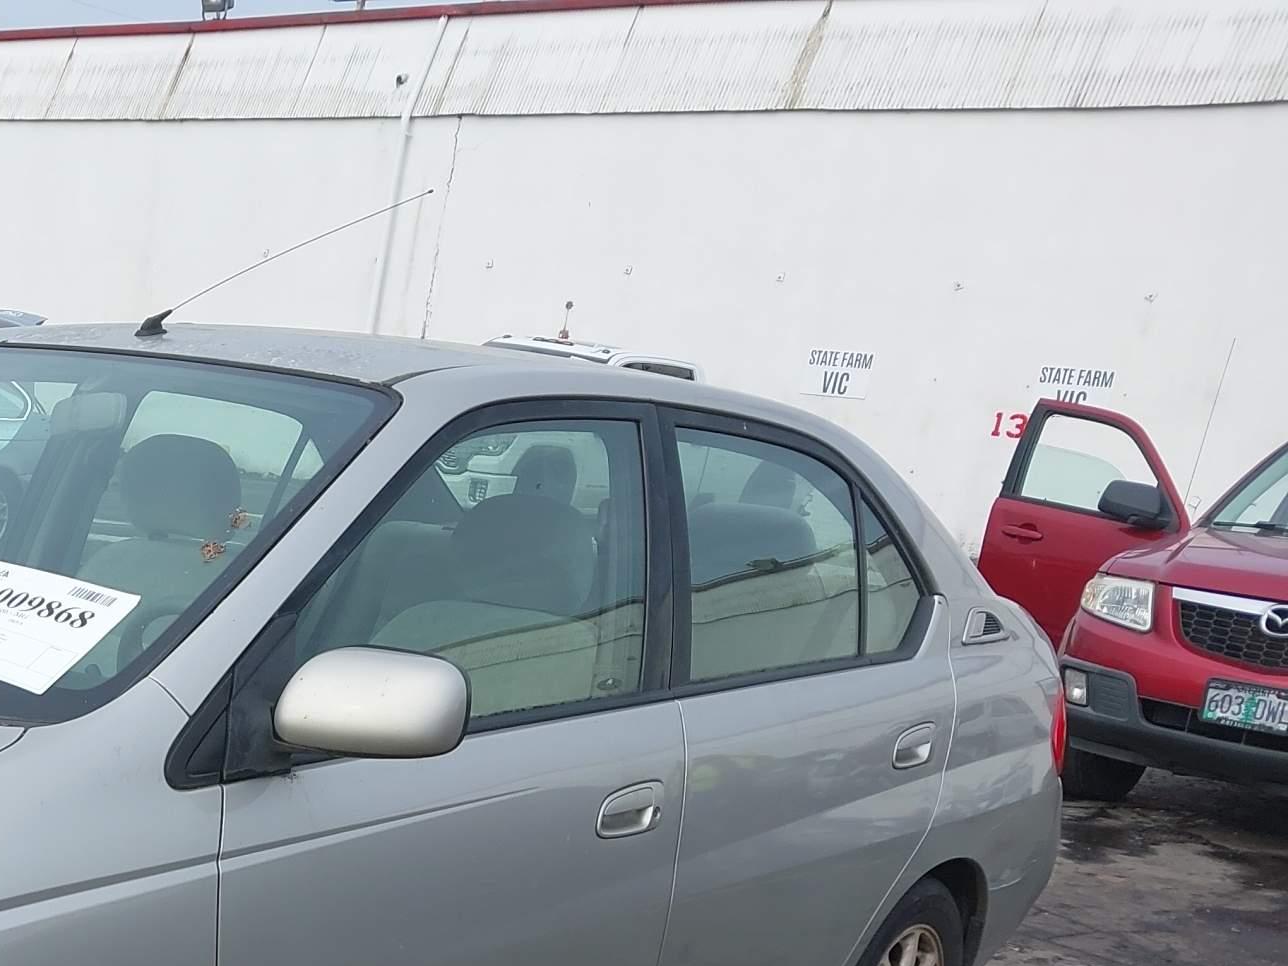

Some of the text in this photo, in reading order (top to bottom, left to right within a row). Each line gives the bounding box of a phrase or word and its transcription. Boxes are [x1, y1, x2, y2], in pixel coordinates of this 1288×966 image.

[809, 350, 874, 370] STATE FARM
[822, 370, 850, 395] VIC
[1039, 366, 1115, 388] STATE FARM
[990, 412, 1029, 439] 13
[1207, 692, 1245, 716] 603
